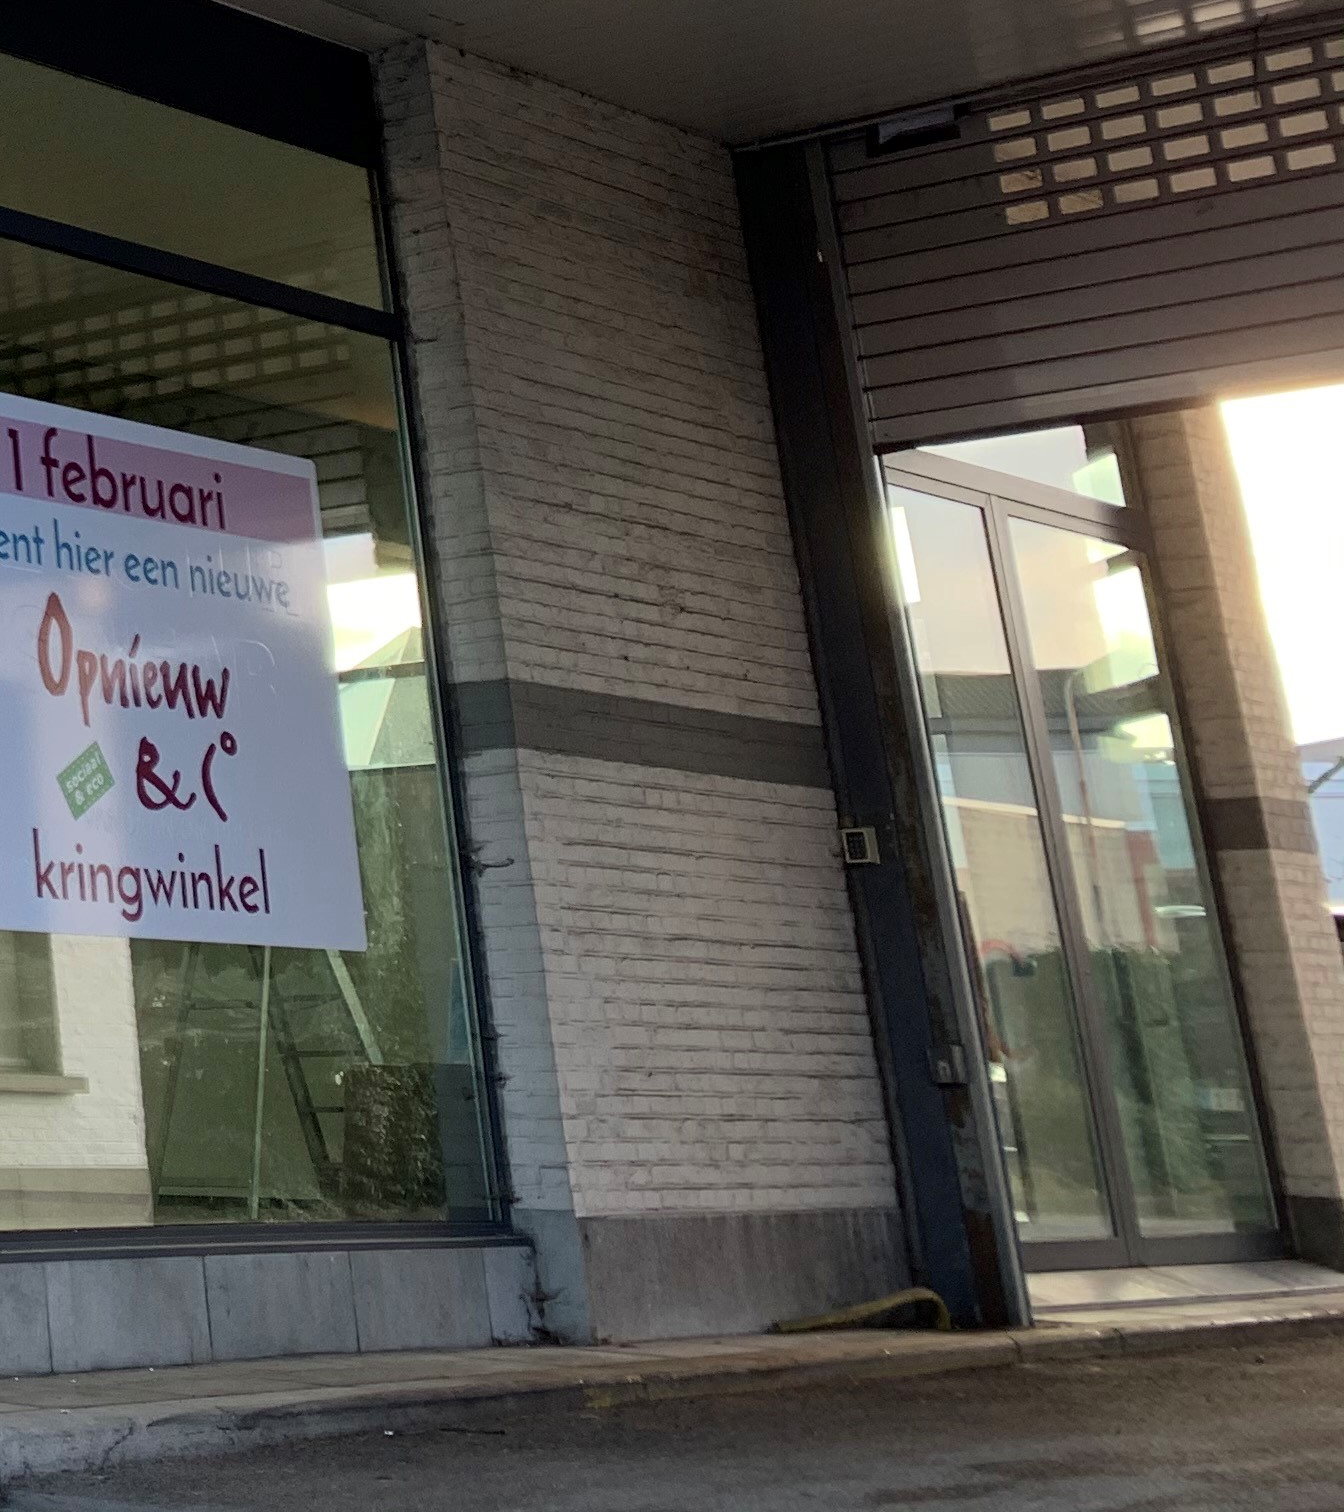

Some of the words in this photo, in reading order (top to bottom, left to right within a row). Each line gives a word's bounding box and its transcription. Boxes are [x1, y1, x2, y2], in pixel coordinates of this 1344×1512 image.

[6, 425, 25, 493] 1
[39, 425, 227, 532] februari
[51, 517, 116, 578] hier
[122, 551, 181, 591] een
[187, 553, 291, 610] nieuwe
[35, 590, 232, 729] Opnieuw
[65, 750, 102, 794] sociaal
[85, 772, 105, 796] eco
[31, 827, 271, 924] kringwinkel
